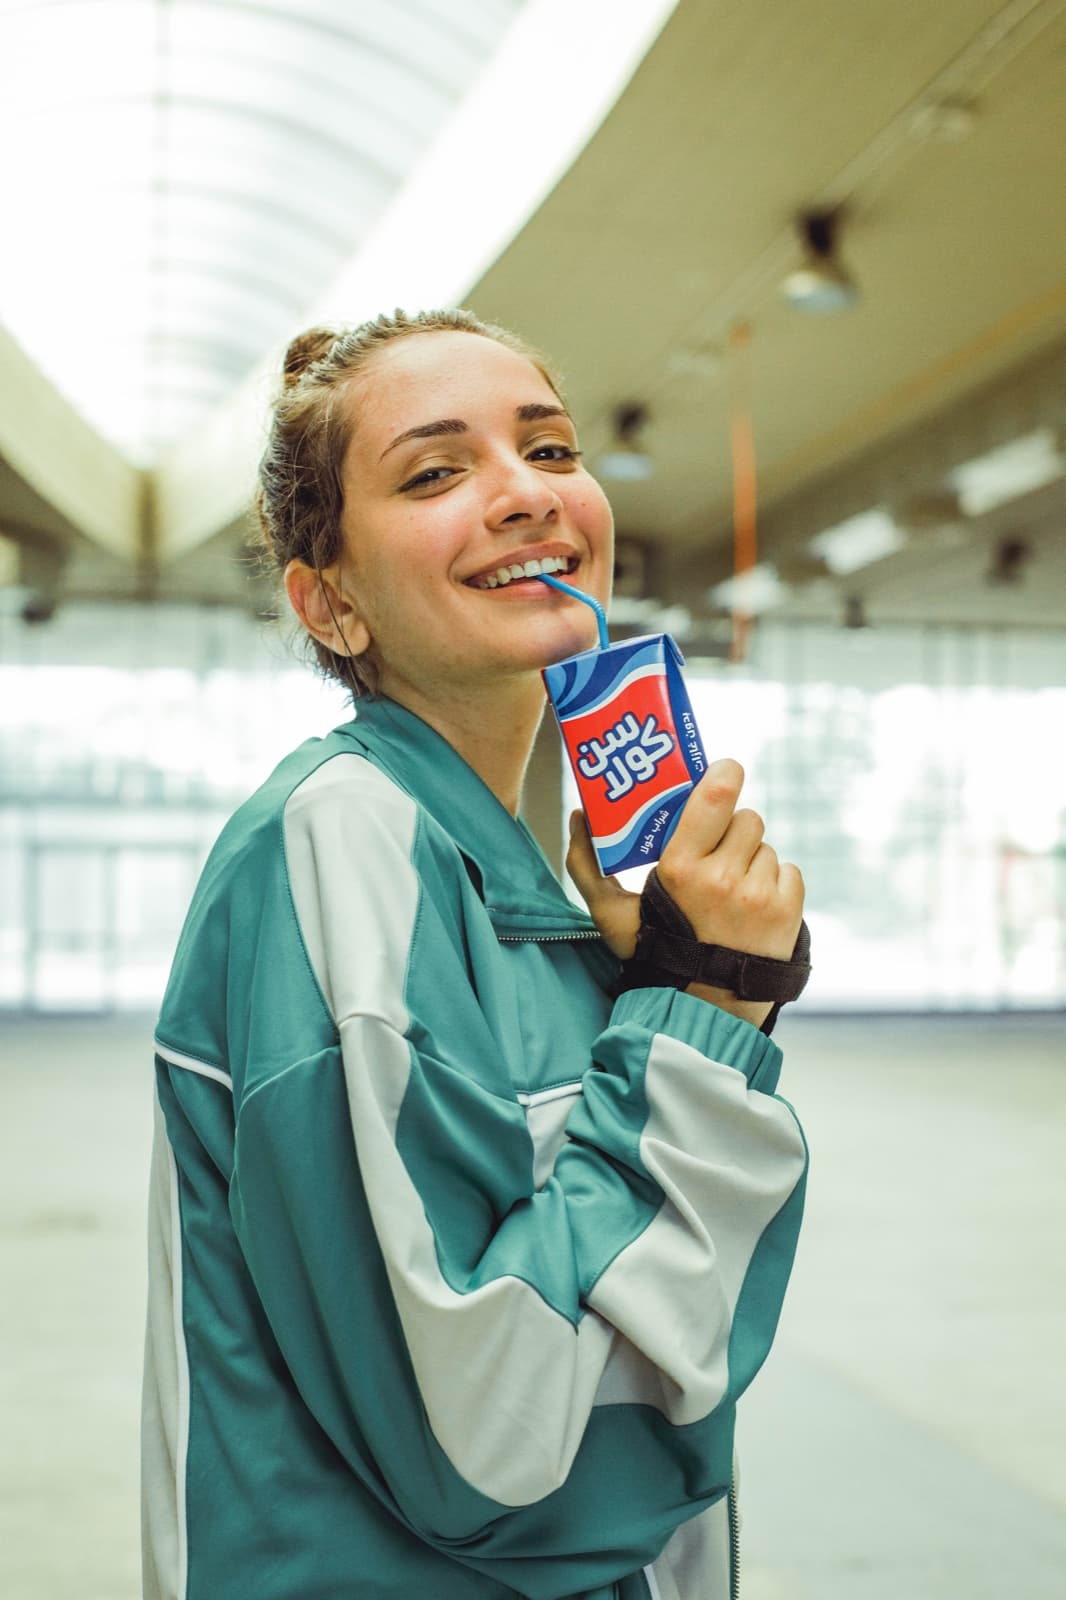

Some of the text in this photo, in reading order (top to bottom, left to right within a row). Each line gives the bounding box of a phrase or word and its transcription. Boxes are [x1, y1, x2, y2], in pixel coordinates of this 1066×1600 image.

[579, 714, 641, 777] سن
[605, 716, 673, 800] كولا
[682, 712, 704, 772] بدون غازات
[640, 810, 669, 855] شراب كولا
